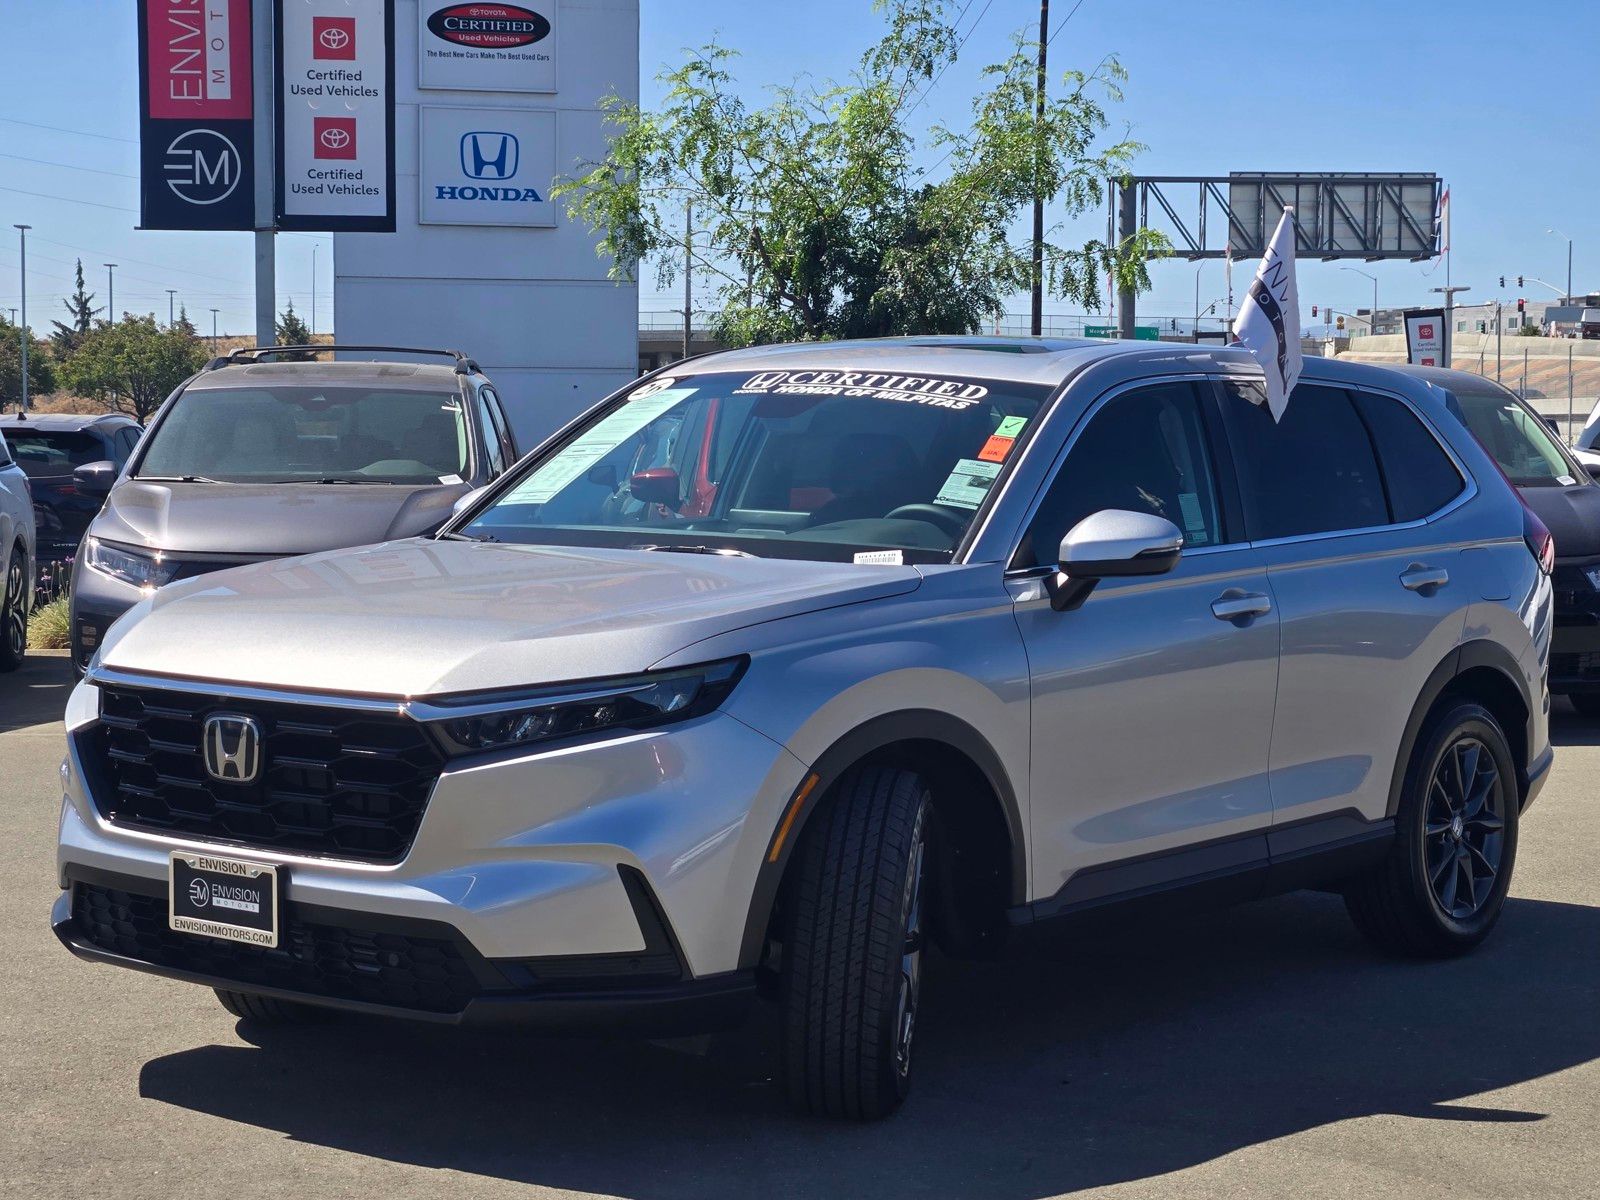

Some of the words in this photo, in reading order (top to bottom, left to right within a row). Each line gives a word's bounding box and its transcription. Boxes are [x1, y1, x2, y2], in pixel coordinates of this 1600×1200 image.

[443, 17, 535, 32] CERTIFIED
[483, 35, 521, 43] Vehicles
[168, 0, 202, 99] ENVI
[306, 69, 362, 81] Certified
[290, 84, 323, 96] Used
[326, 85, 379, 97] Vehicles
[307, 168, 363, 180] Certified
[291, 183, 324, 195] Used
[326, 184, 380, 196] Vehicles
[435, 186, 543, 202] HONDA
[787, 371, 988, 399] CERTIFIED
[772, 385, 843, 395] HONDA
[844, 388, 876, 397] OF
[872, 391, 971, 409] MILPITAS
[199, 858, 247, 875] ENVISION
[212, 884, 260, 902] ENVISION
[216, 899, 256, 910] MOTORS
[174, 919, 273, 945] ENVISIONMOTORS.COM
